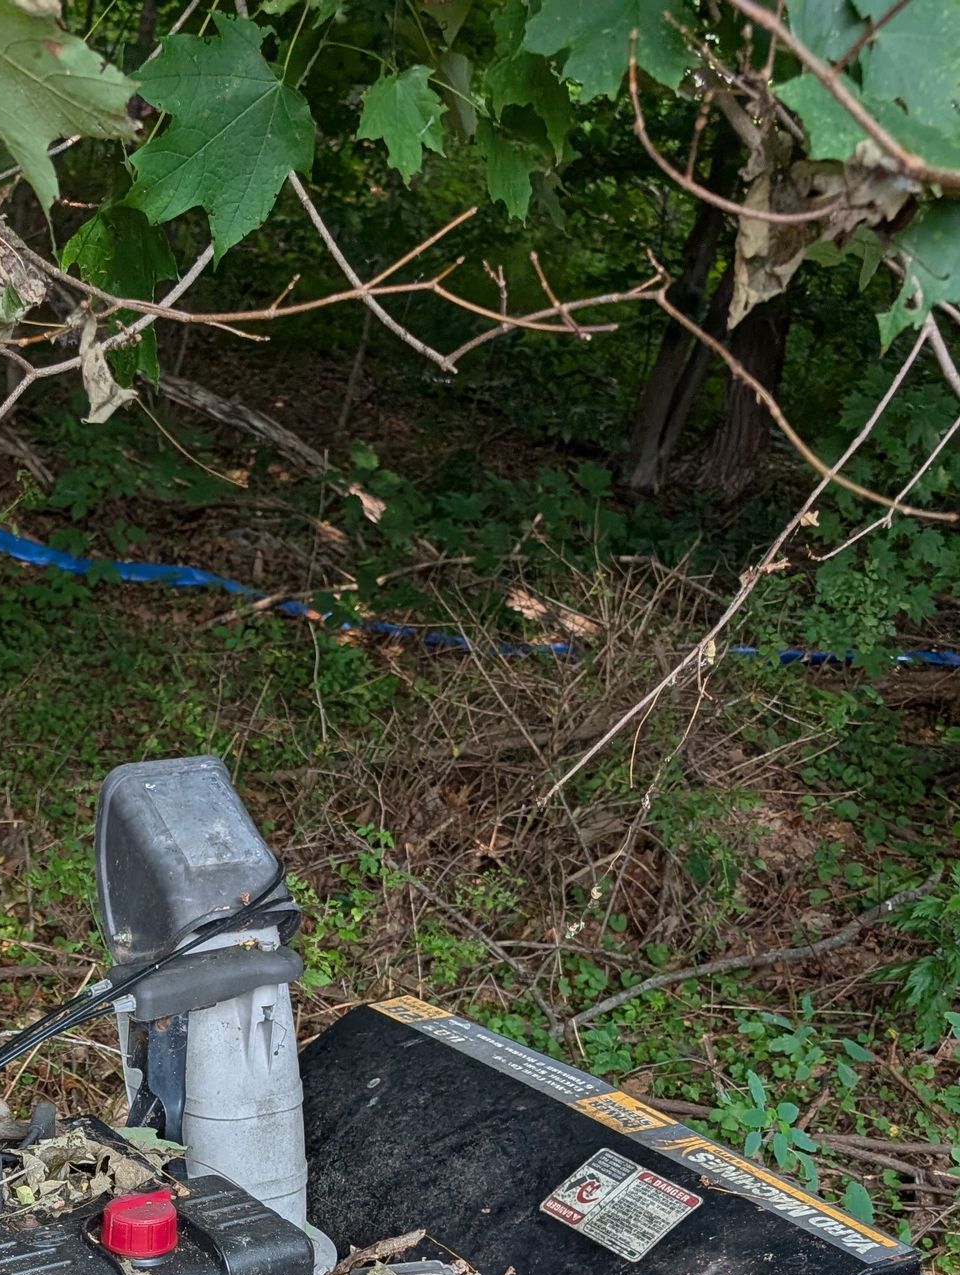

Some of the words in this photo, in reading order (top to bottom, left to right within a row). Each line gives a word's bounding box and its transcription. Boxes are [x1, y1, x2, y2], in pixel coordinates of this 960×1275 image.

[523, 1062, 548, 1075] START
[545, 1065, 586, 1086] FORWARD
[548, 1074, 585, 1092] ELECTRIC
[652, 1178, 691, 1203] DANGER
[687, 1152, 819, 1218] MACHINES
[545, 1199, 574, 1218] DANGER
[808, 1215, 881, 1255] YARD
